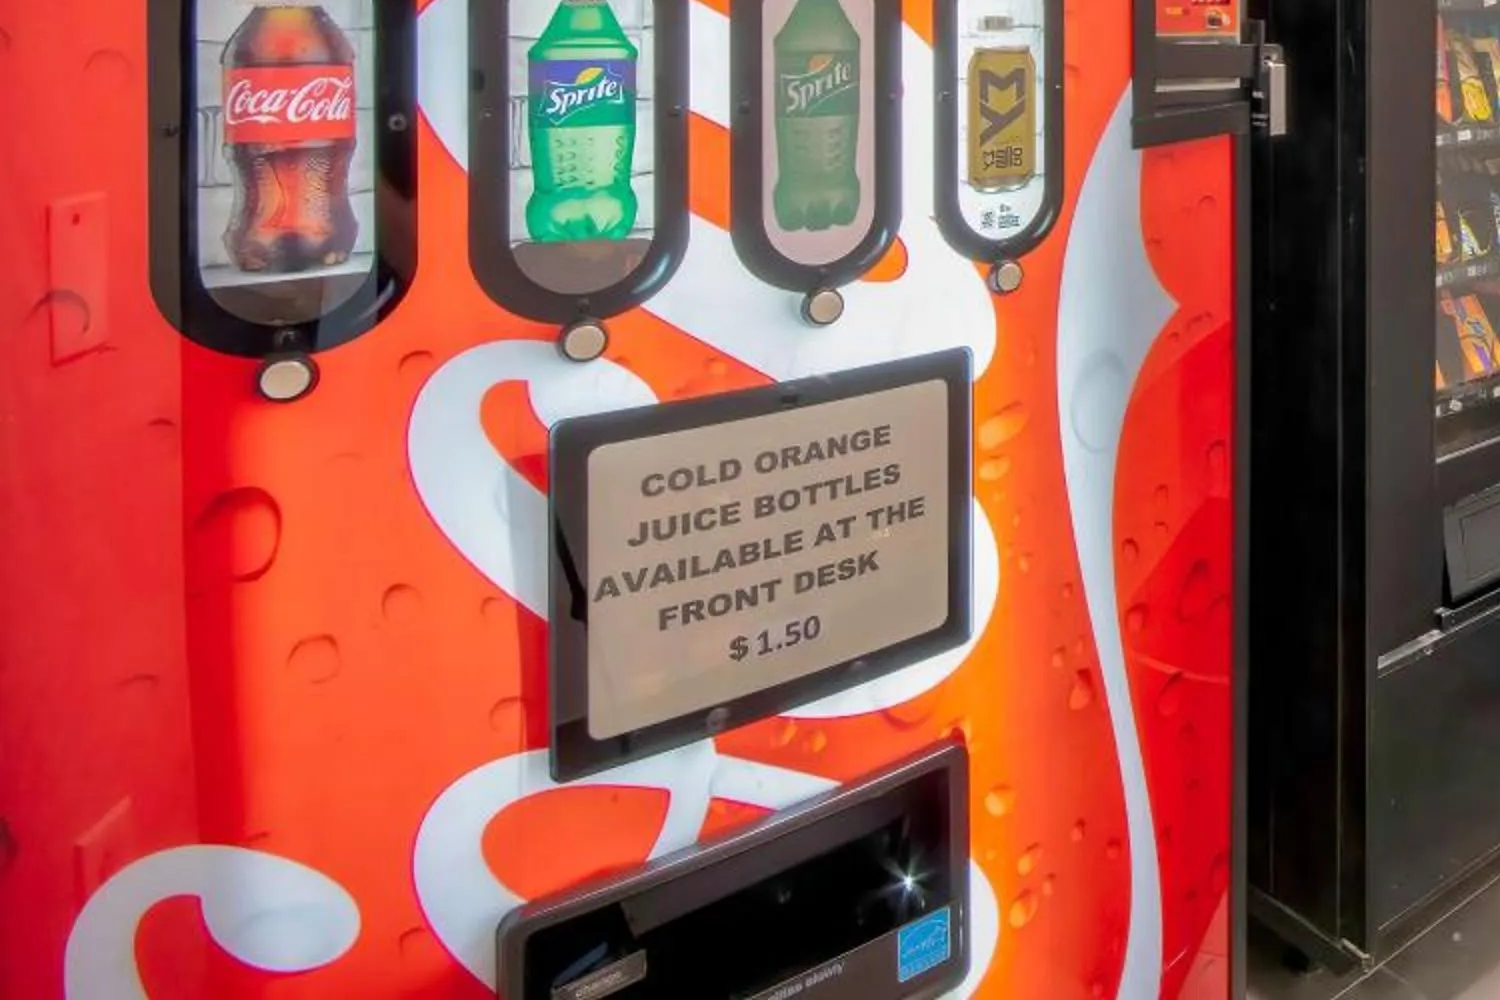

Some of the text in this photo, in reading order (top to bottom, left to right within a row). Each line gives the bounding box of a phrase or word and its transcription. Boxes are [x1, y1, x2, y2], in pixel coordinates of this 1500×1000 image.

[225, 73, 353, 125] Coca-Cola
[544, 78, 620, 116] Sprite
[784, 60, 851, 115] Sprite
[640, 424, 892, 498] COLD ORANGE
[626, 463, 902, 548] JUICE BOTTLES
[593, 496, 927, 602] AVAILABLE AT THE
[658, 550, 880, 632] FRONT DESK
[728, 614, 821, 662] $1.50
